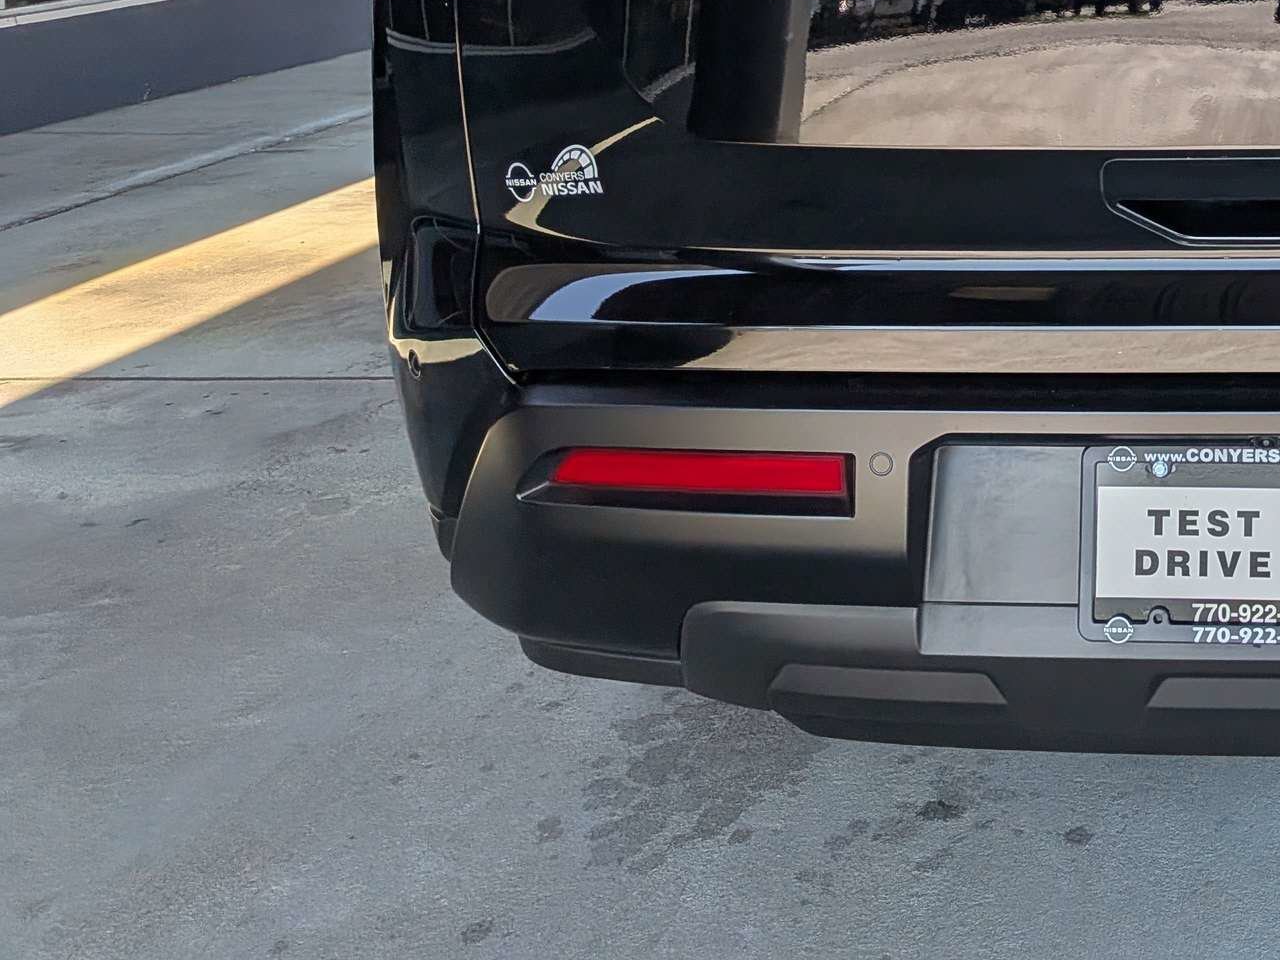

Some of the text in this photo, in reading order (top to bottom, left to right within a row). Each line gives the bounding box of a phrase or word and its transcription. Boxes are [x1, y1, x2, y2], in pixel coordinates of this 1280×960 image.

[506, 179, 536, 187] NISSAN
[540, 171, 585, 182] CONYERS
[541, 180, 604, 196] NISSAN
[1147, 509, 1260, 537] TEST
[1134, 549, 1271, 578] DRIVE
